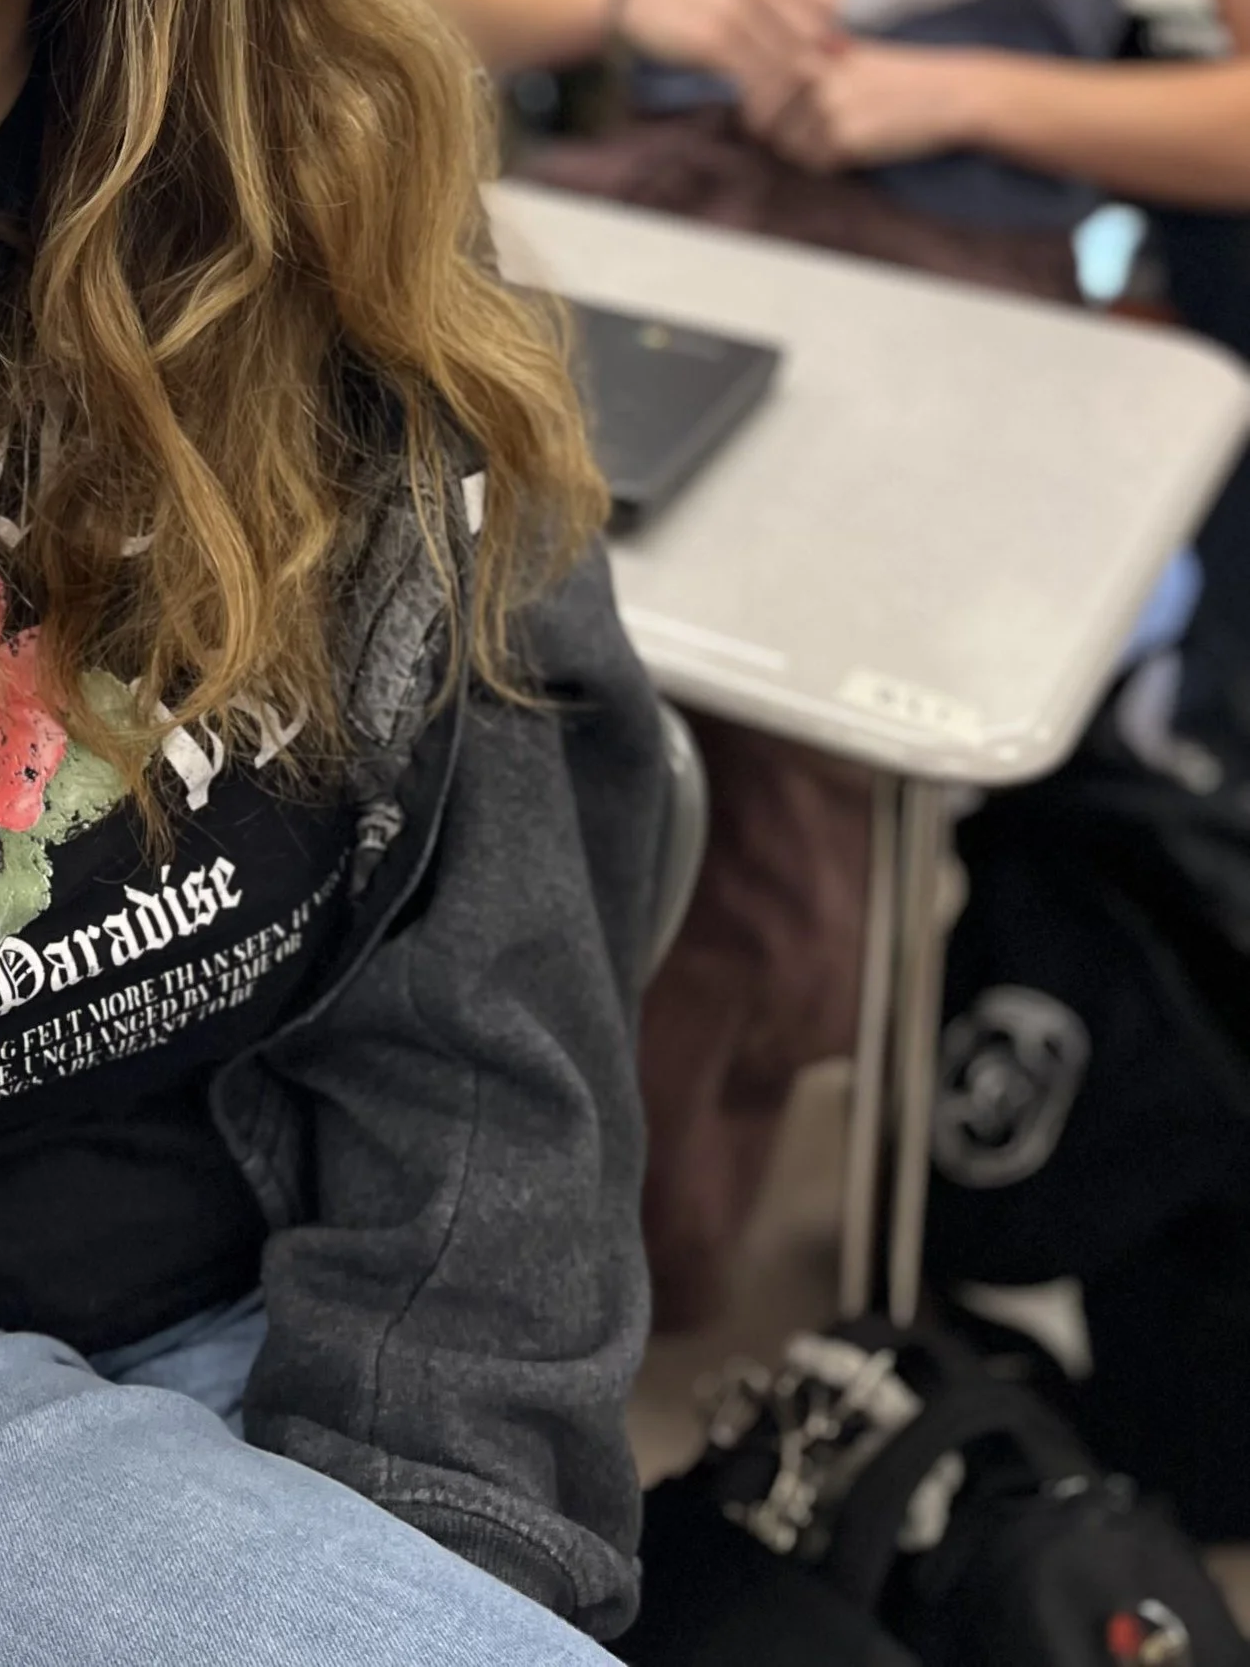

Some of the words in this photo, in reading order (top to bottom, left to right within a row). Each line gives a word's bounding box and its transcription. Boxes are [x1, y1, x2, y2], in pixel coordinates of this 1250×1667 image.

[22, 1008, 82, 1053] FELT
[88, 978, 157, 1022] MORE
[161, 949, 229, 995] THAN
[23, 996, 178, 1075] UNCHANGED
[183, 979, 213, 1009] BY
